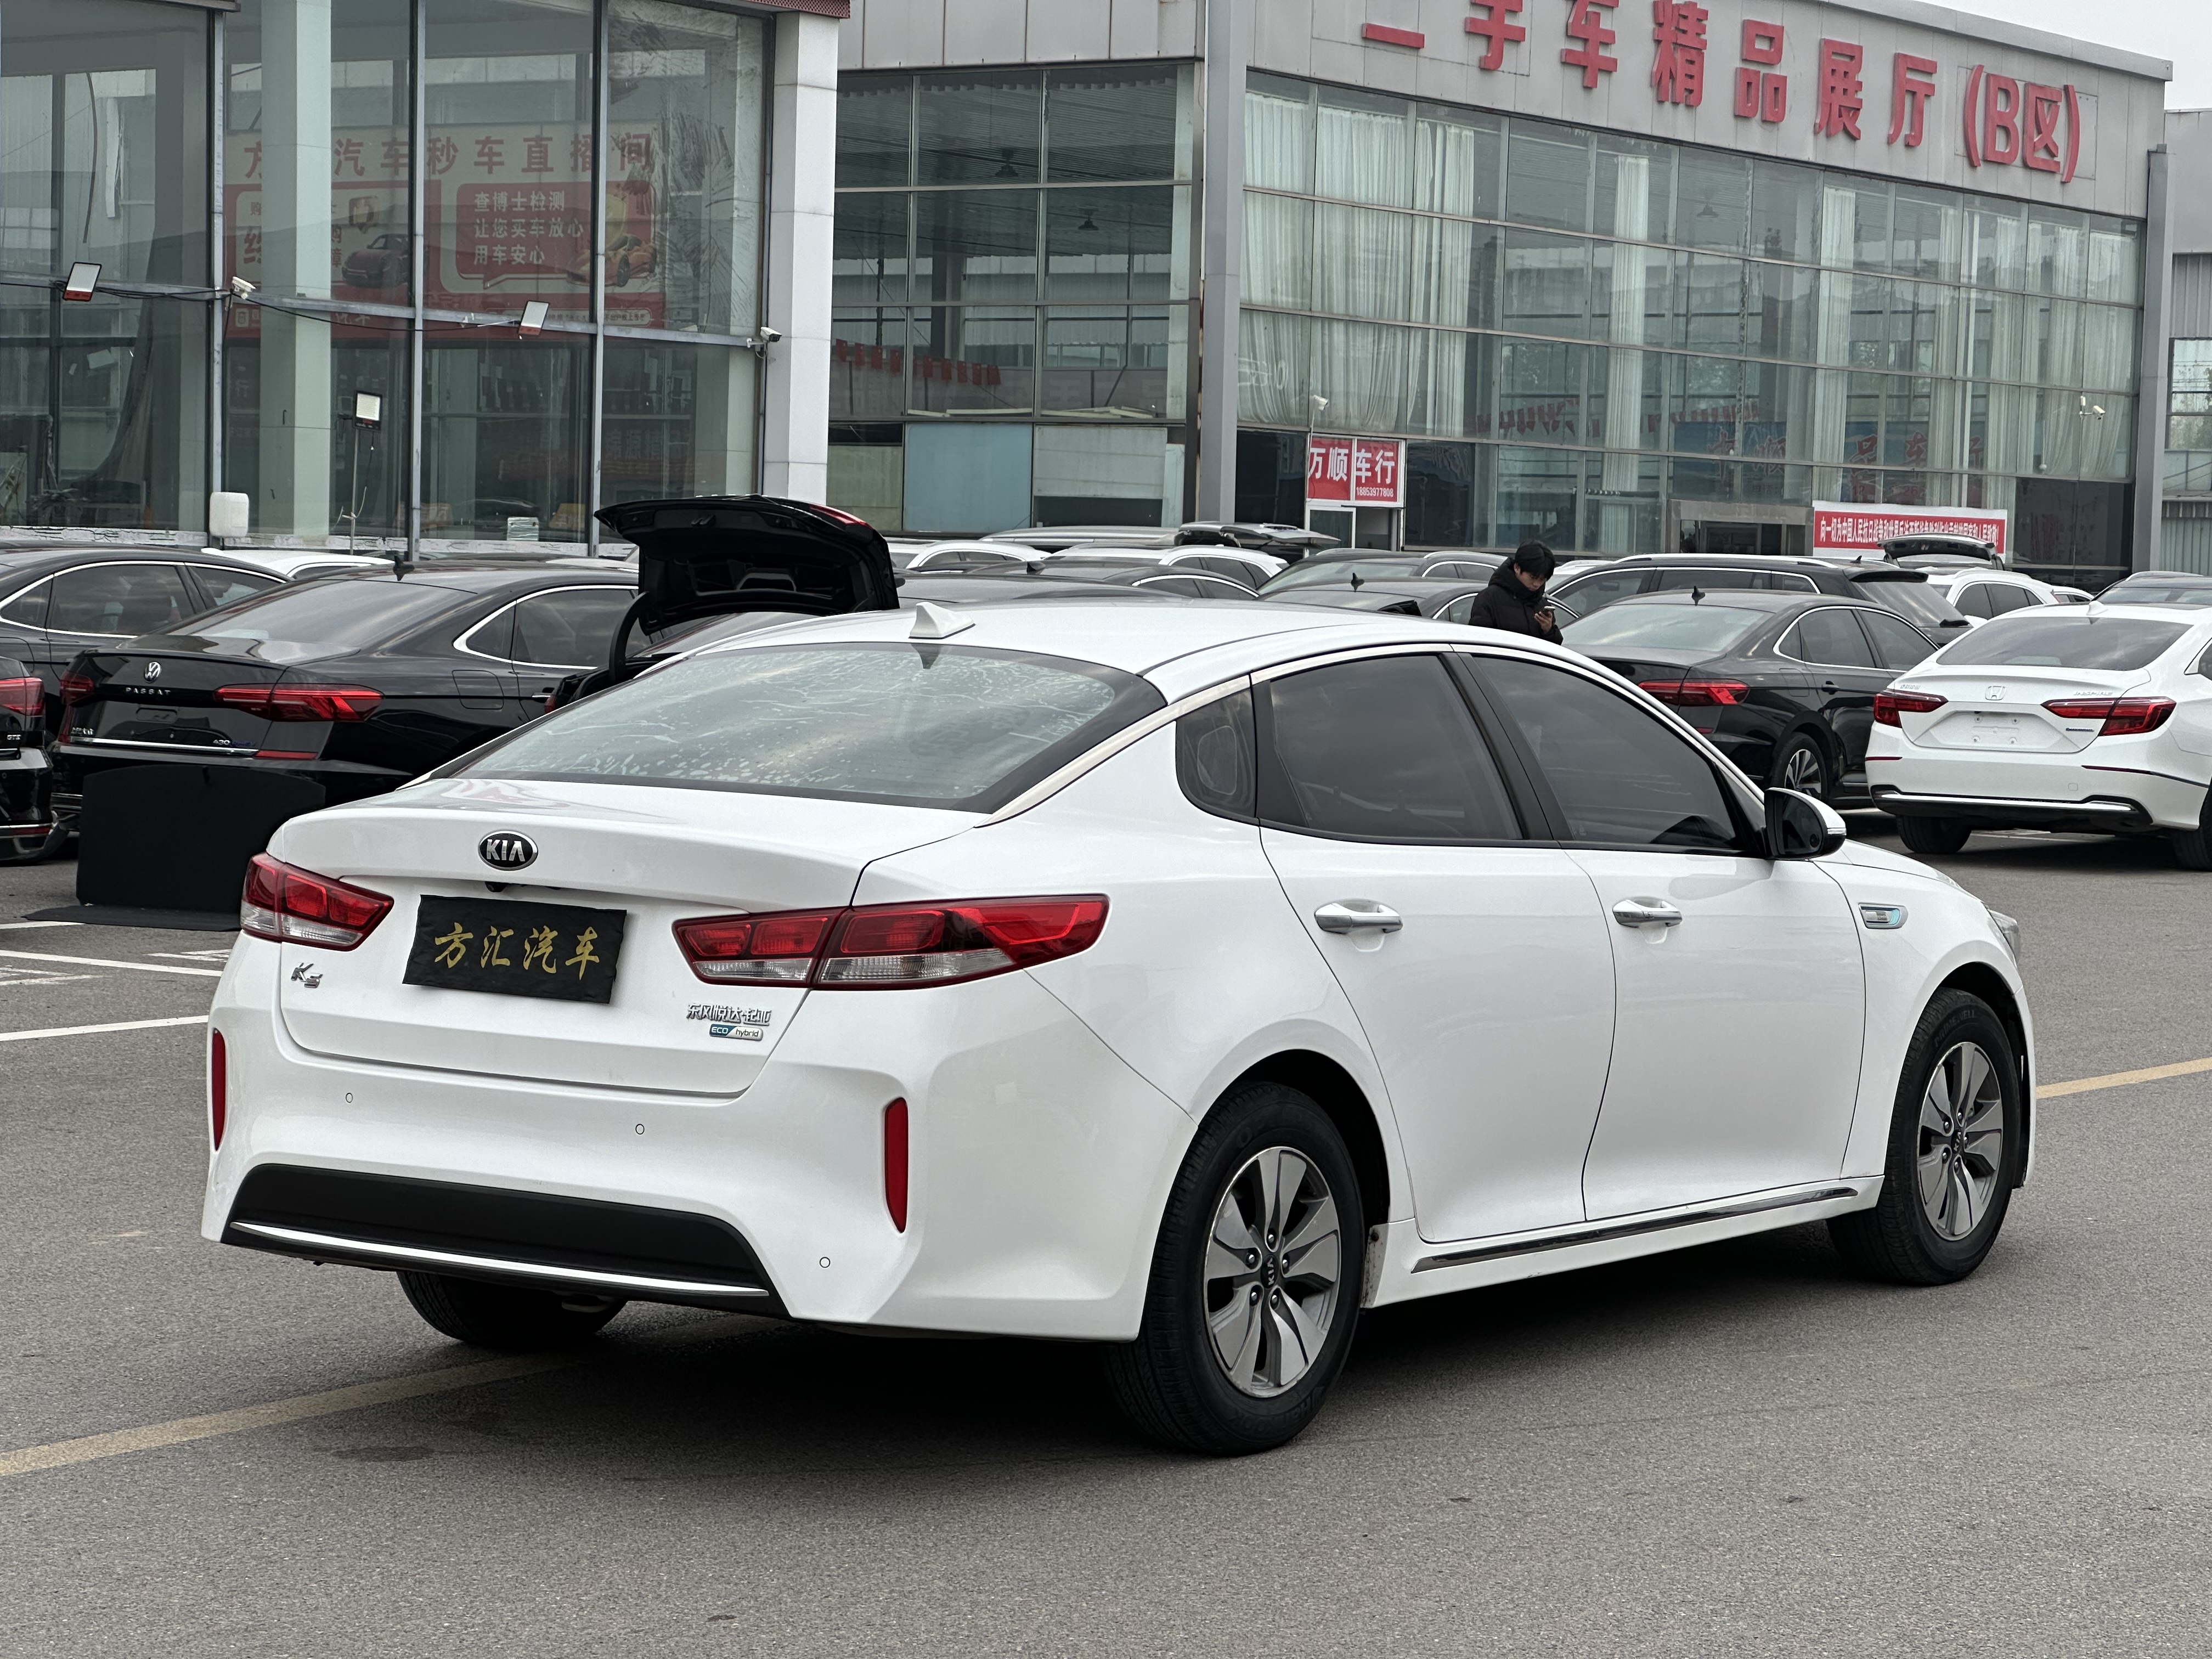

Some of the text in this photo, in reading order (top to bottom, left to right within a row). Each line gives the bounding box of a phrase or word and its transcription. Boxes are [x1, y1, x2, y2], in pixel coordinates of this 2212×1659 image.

[244, 132, 651, 179] 方汽车秒车直播间
[474, 190, 565, 213] 查博士检测
[473, 217, 584, 240] 让您买车放心
[473, 244, 545, 266] 用车安心
[1356, 487, 1394, 498] 18853977808
[125, 687, 171, 696] PASSAT
[486, 838, 525, 862] KIA
[434, 922, 601, 981] 方汇汽车
[291, 962, 323, 989] K5
[711, 1026, 759, 1037] ECO hybrid
[1953, 1131, 1963, 1152] KIA
[1267, 1258, 1278, 1287] KIA
